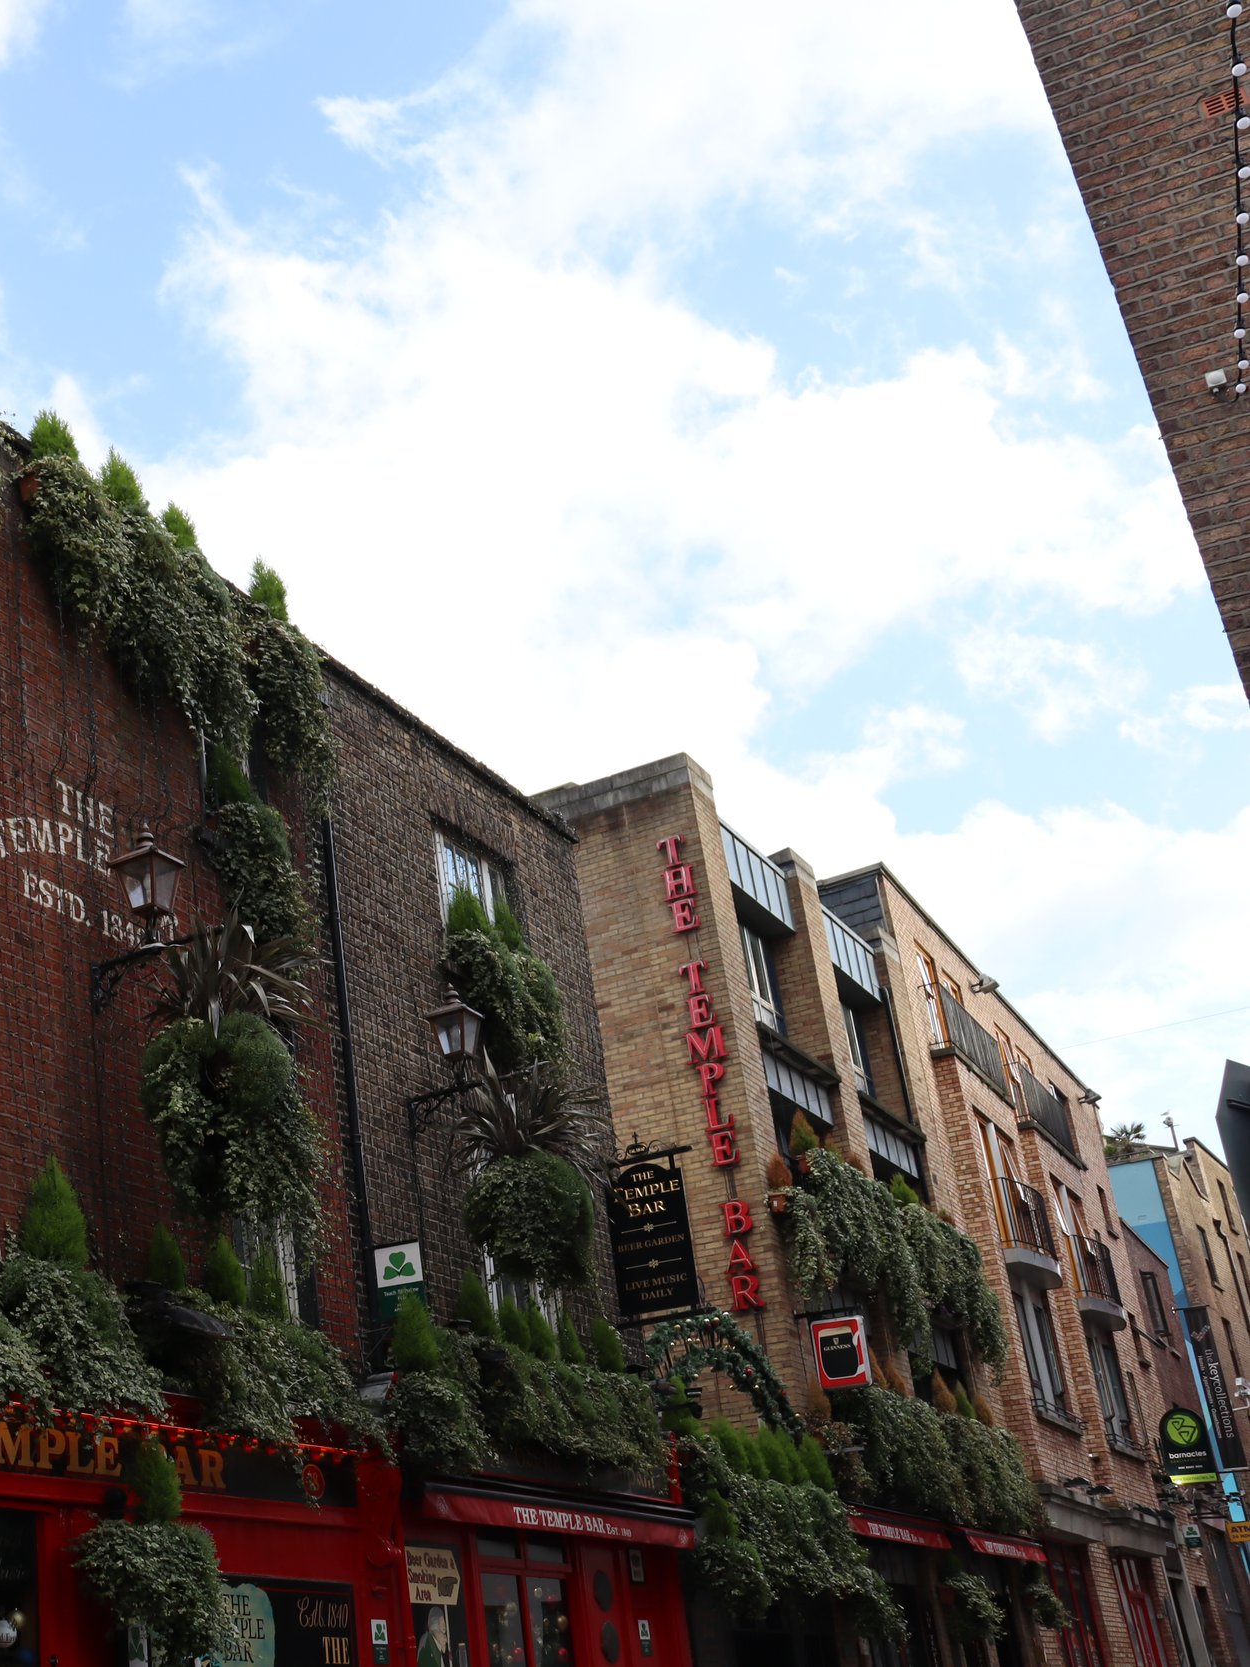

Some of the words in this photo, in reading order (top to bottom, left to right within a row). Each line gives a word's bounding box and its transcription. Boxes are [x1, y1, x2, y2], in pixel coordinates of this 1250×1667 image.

[55, 779, 115, 839] THE
[656, 834, 701, 932] THE
[21, 869, 91, 927] ESTD.
[678, 959, 740, 1167] TEMPLE
[630, 1170, 654, 1182] THE
[627, 1200, 666, 1218] BAR
[618, 1242, 642, 1252] BEER
[644, 1233, 685, 1248] GARDEN
[718, 1199, 766, 1312] BAR
[625, 1278, 650, 1291] LIVE
[652, 1272, 687, 1287] MUSIC
[640, 1287, 674, 1301] DAILY
[823, 1343, 852, 1351] GUINNESS
[1169, 1451, 1207, 1460] barnacles
[157, 1443, 228, 1490] AR
[513, 1506, 539, 1526] THE
[539, 1509, 583, 1531] TEMPLE
[584, 1515, 606, 1535] BAR
[406, 1550, 422, 1567] Beer
[424, 1552, 449, 1569] Garden
[408, 1568, 437, 1588] Smoking
[416, 1586, 432, 1601] Area
[328, 1602, 349, 1629] 1840
[322, 1636, 350, 1665] THE
